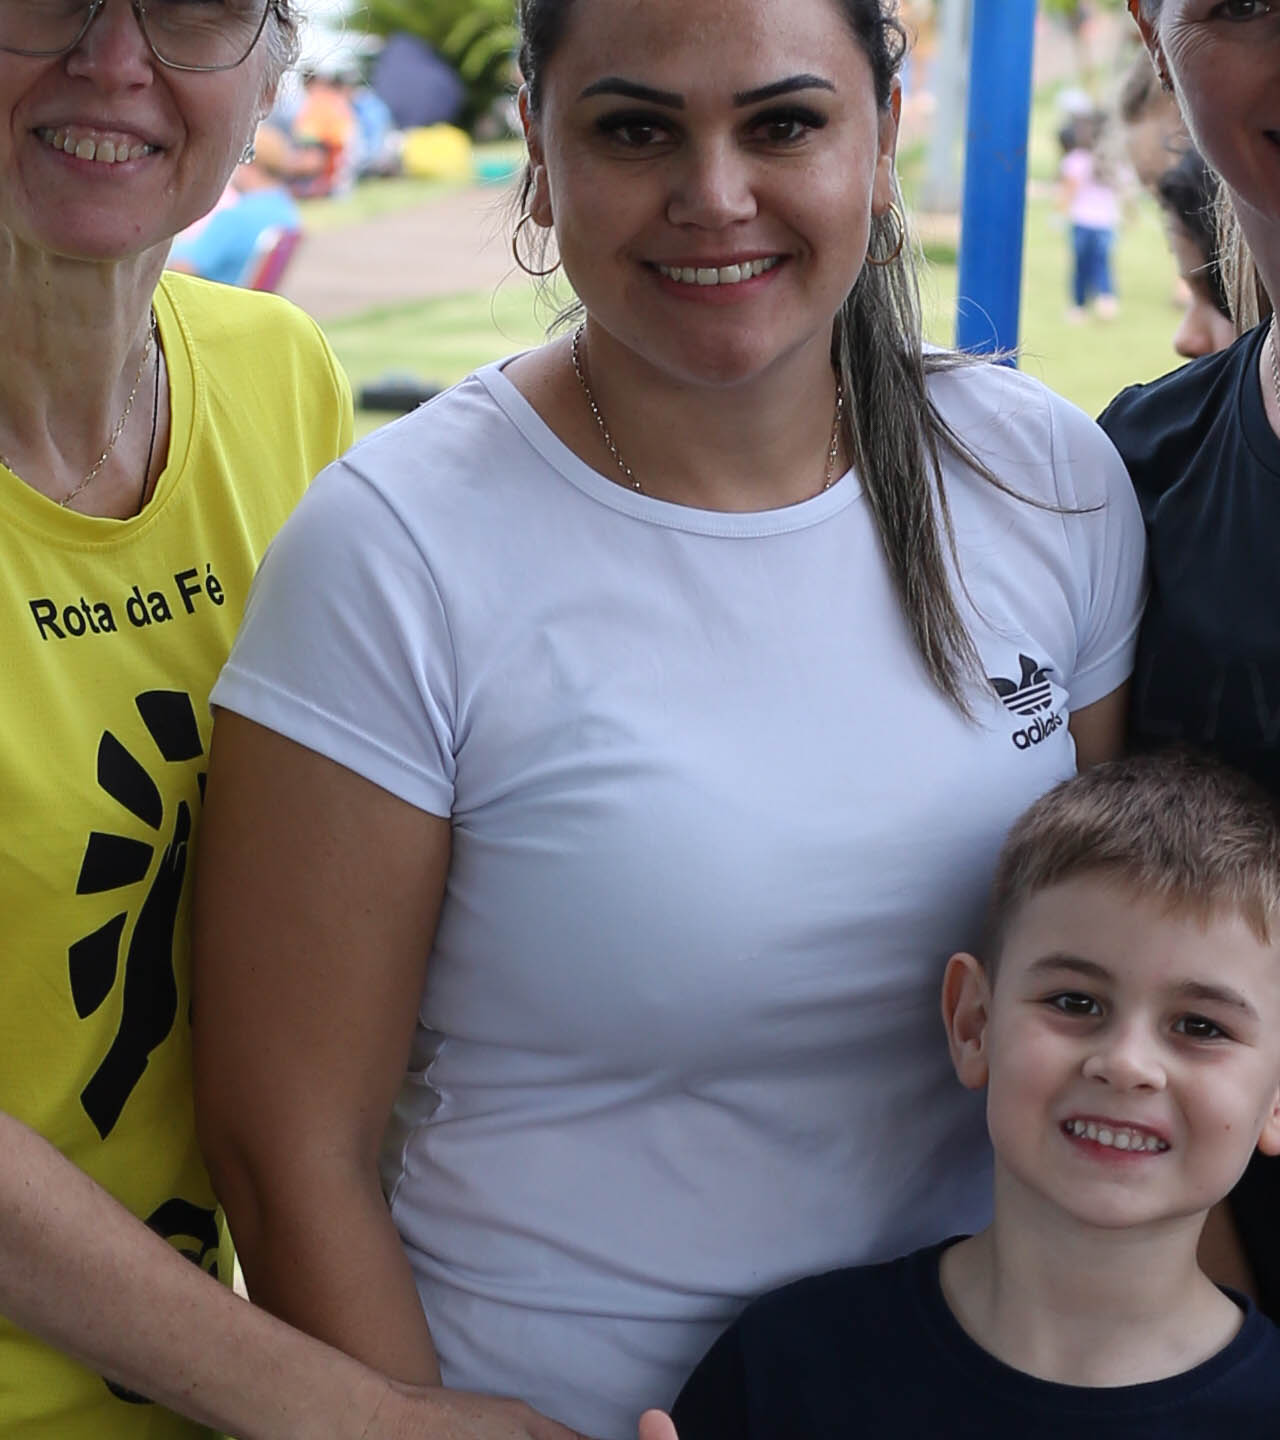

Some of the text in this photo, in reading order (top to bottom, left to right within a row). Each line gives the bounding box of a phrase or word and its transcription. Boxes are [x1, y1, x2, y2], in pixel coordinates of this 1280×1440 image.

[28, 562, 224, 641] Rota da Fé
